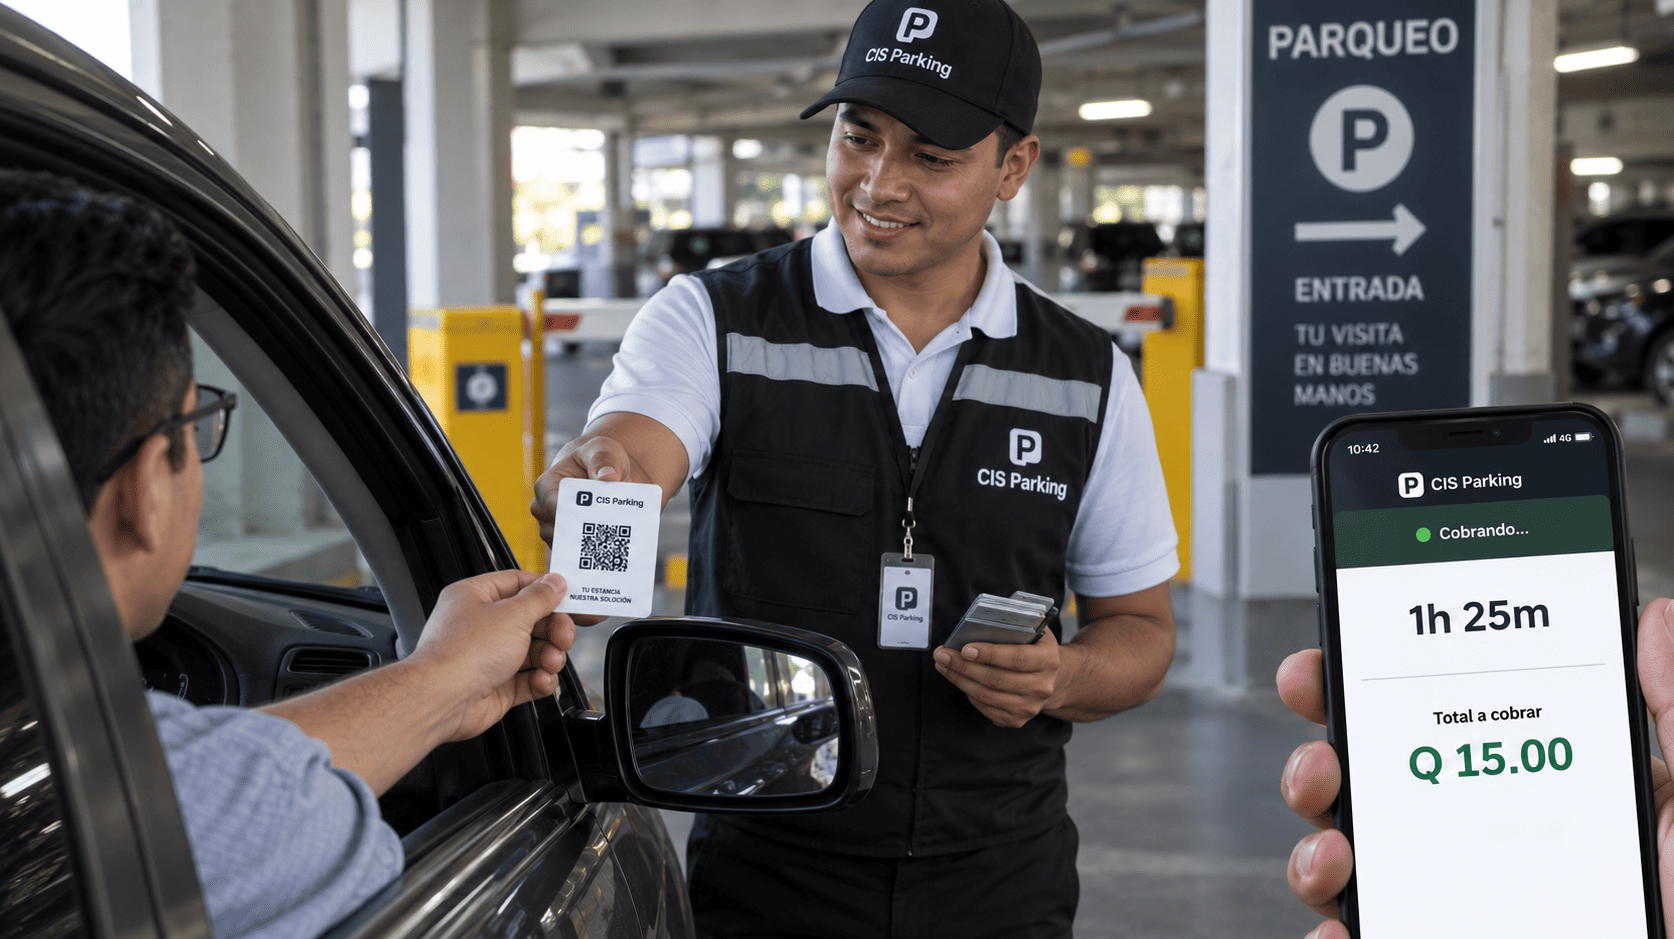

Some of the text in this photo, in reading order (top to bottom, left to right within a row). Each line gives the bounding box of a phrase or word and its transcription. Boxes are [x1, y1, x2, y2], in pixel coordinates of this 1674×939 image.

[1268, 17, 1460, 60] PARQUEO
[865, 47, 953, 79] CIS Parking
[1341, 108, 1391, 173] P
[1295, 274, 1425, 303] ENTRADA
[1294, 322, 1404, 346] TU VISITA
[1294, 352, 1419, 377] EN BUENAS
[1294, 382, 1376, 407] MANOS
[1347, 443, 1380, 455] 10:42
[1559, 433, 1572, 442] 4G
[977, 468, 1067, 501] CIS Parking
[1431, 476, 1458, 491] CIS
[1462, 472, 1522, 490] Parking
[596, 496, 611, 504] CIS
[612, 498, 644, 508] Parking
[1439, 523, 1529, 540] Cobrando...
[590, 587, 621, 595] ESTANCIA
[887, 613, 924, 623] CIS Parking
[1409, 600, 1550, 635] 1h 25m
[1433, 706, 1542, 725] Total a cobrar
[1409, 737, 1573, 785] Q 15.00
